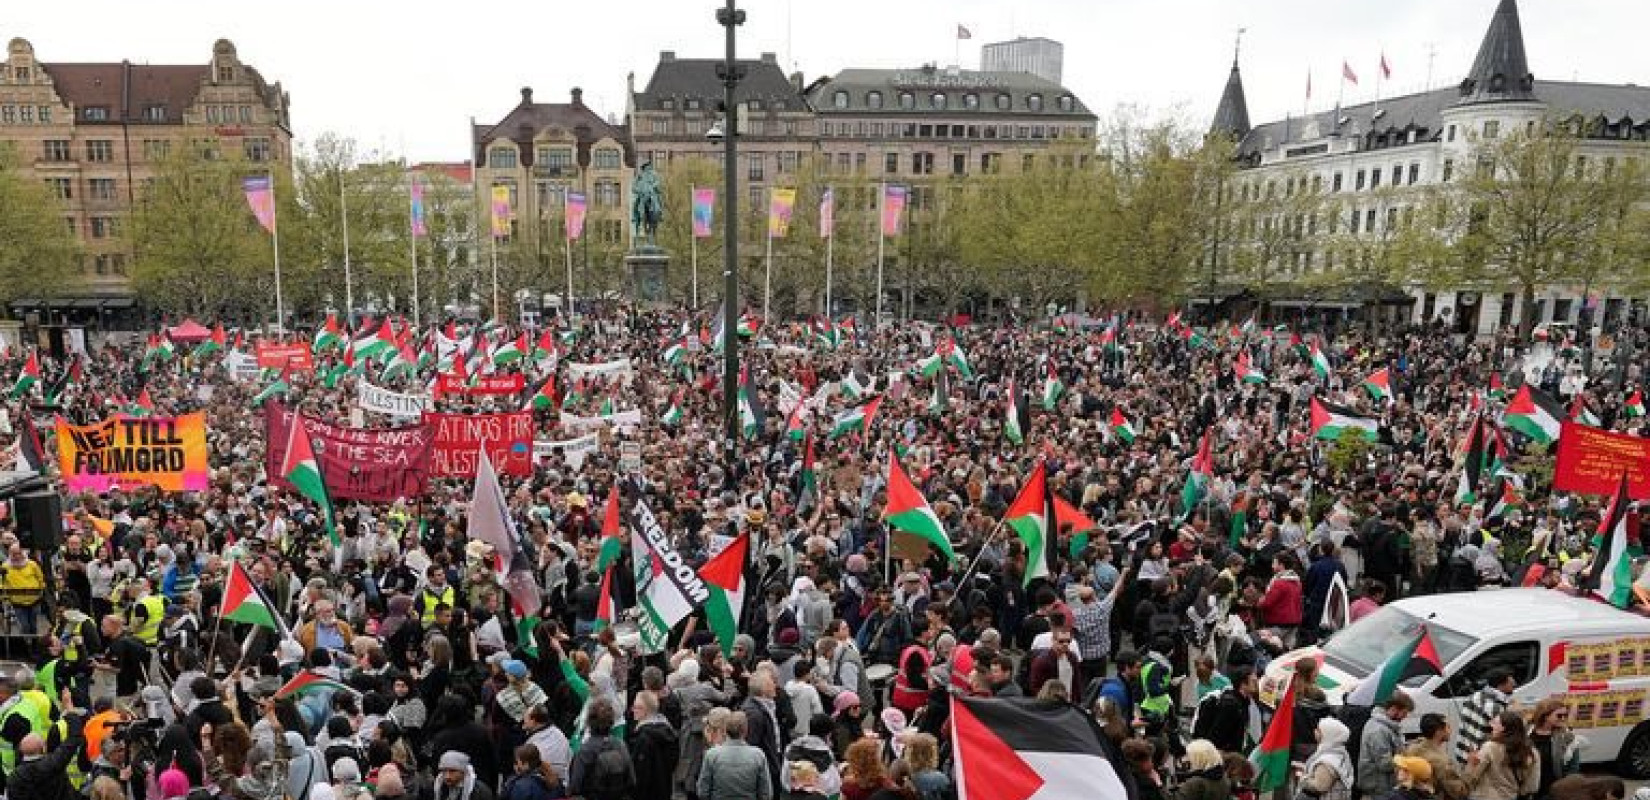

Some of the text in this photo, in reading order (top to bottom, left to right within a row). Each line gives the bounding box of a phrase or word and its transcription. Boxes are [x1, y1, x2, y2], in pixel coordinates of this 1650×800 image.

[68, 419, 183, 452] NEJ TILL
[376, 430, 424, 447] RIVER
[508, 414, 532, 440] FOR
[333, 442, 410, 466] THE SEA
[631, 498, 710, 603] FREEDOM
